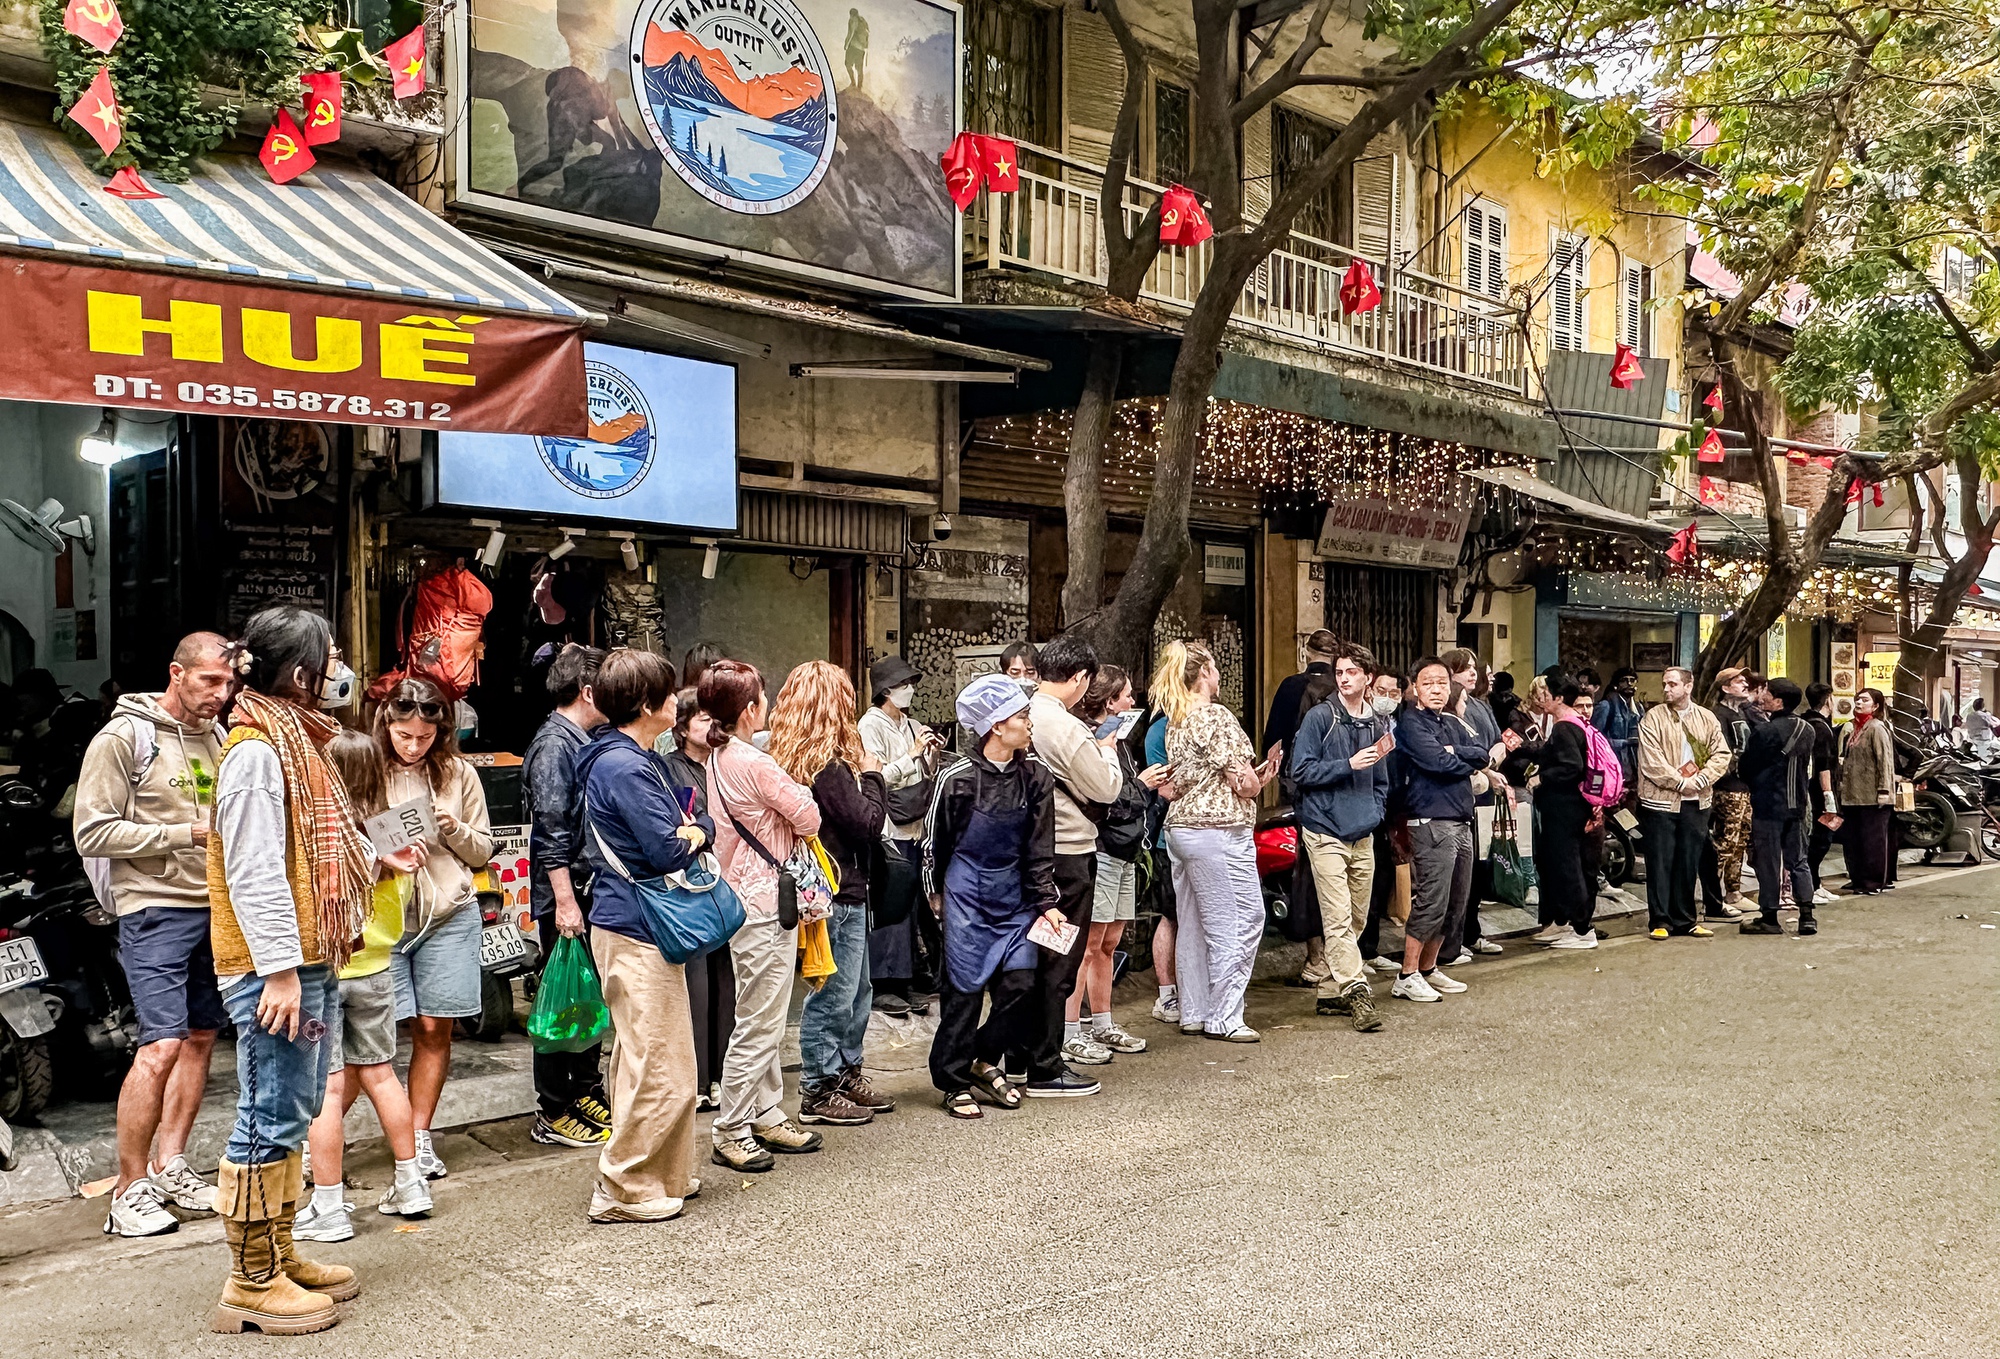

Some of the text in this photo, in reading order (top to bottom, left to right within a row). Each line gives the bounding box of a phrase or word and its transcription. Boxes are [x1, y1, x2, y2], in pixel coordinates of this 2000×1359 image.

[715, 23, 764, 54] OUTFIT
[743, 201, 771, 213] THE
[87, 289, 491, 387] HUẾ
[93, 373, 451, 422] ĐT: 035.5878.312
[589, 375, 637, 414] ERLUST
[399, 808, 425, 837] 020
